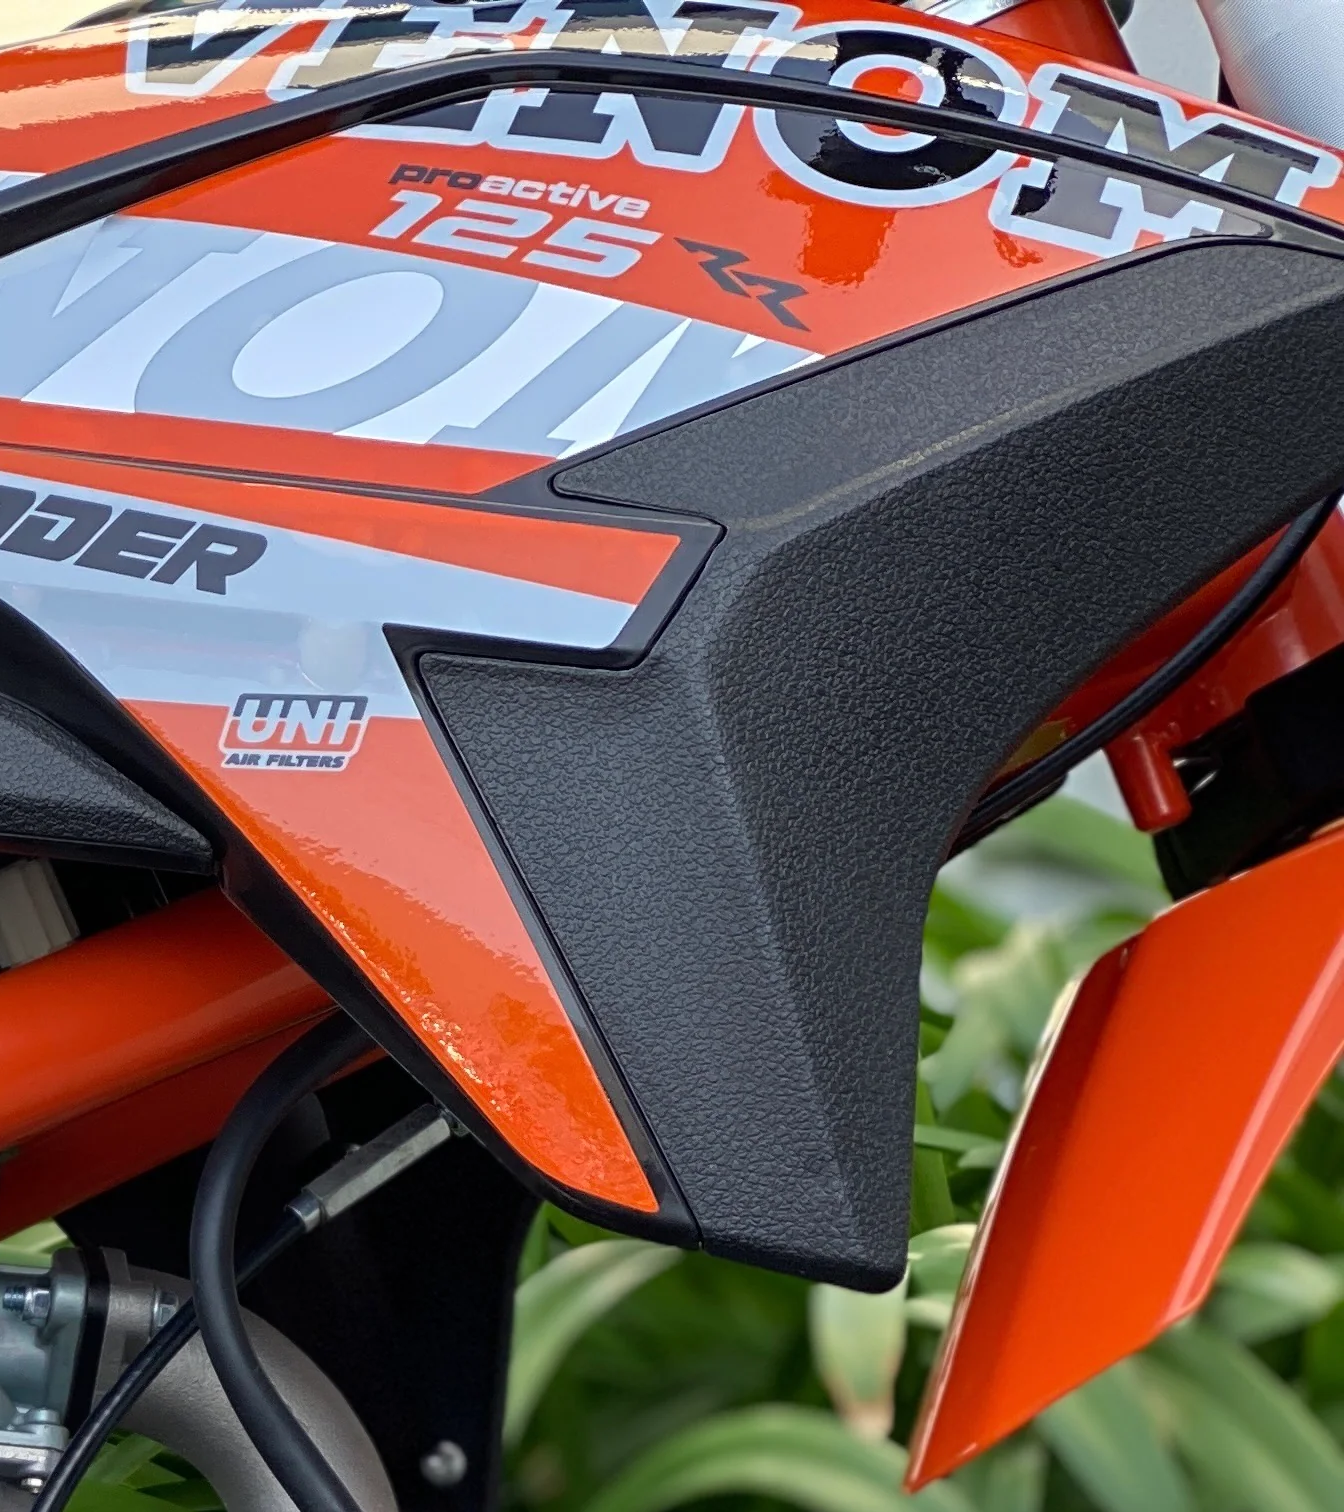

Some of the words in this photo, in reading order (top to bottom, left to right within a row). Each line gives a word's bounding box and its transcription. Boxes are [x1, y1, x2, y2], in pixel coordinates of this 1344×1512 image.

[389, 163, 651, 219] proactive
[369, 190, 664, 278] 125
[236, 699, 356, 745] UNI
[224, 752, 262, 766] AIR
[265, 753, 347, 768] FILTERS
